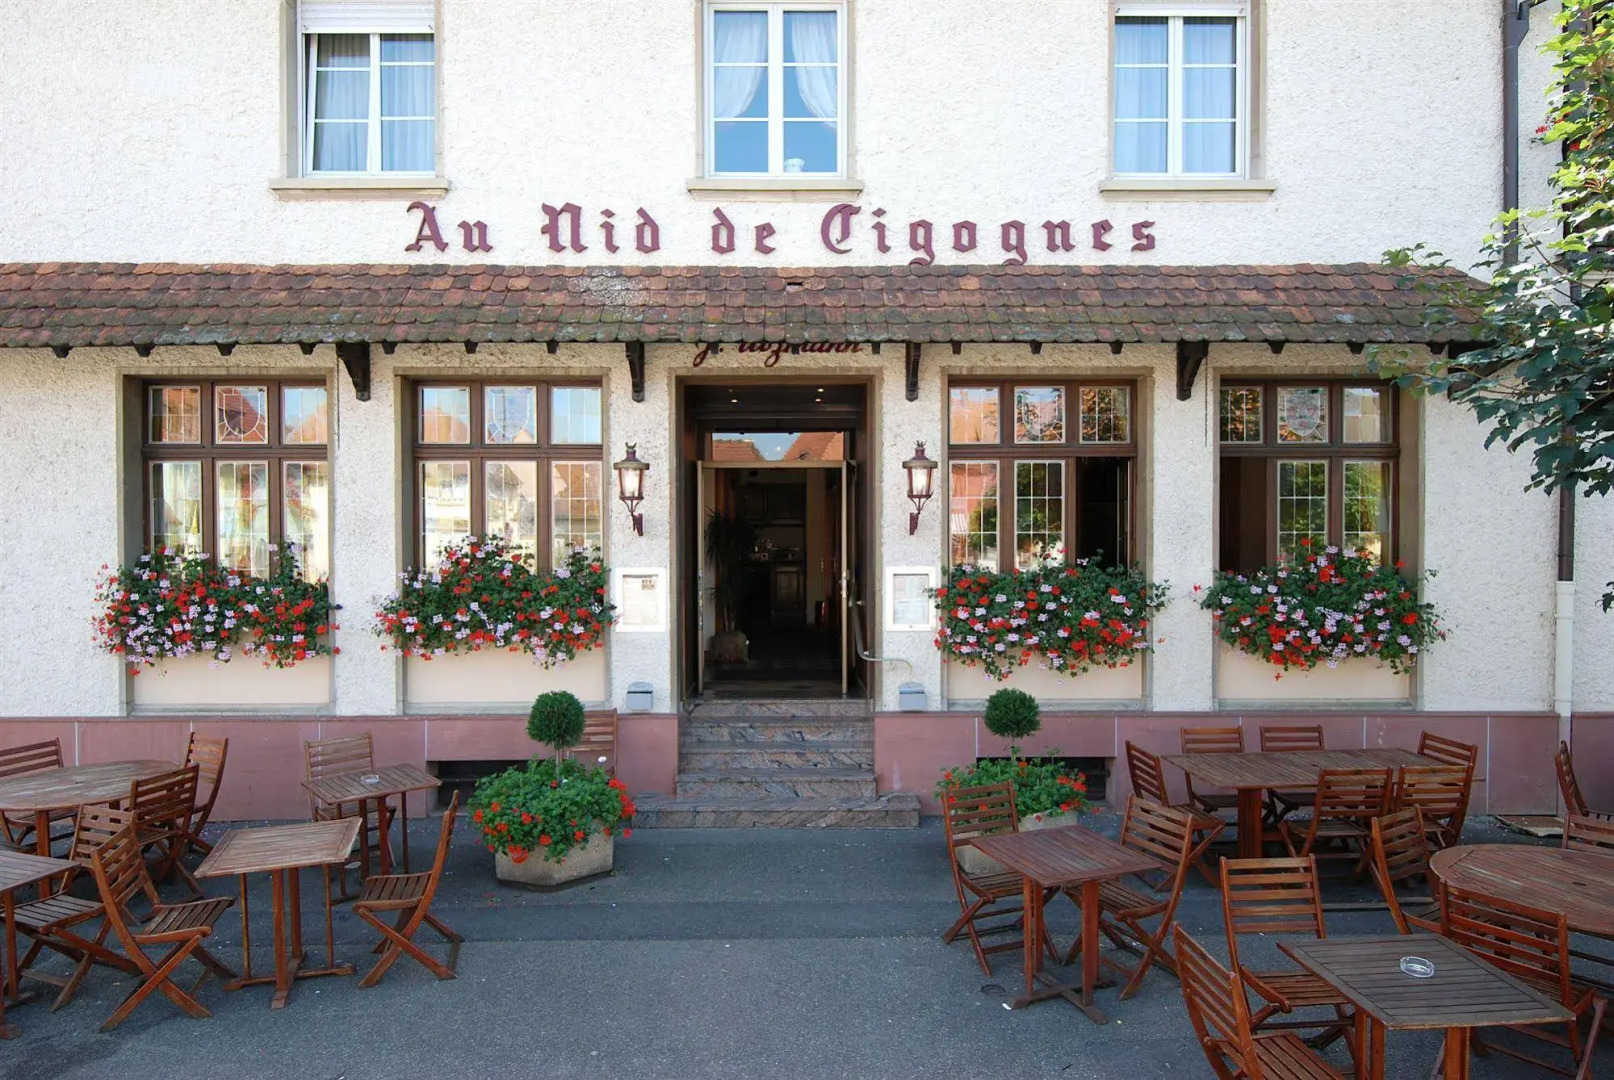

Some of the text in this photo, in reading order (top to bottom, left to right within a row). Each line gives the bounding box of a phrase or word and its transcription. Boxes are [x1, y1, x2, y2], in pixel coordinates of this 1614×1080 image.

[404, 201, 1156, 267] Au Nid de Cigognes
